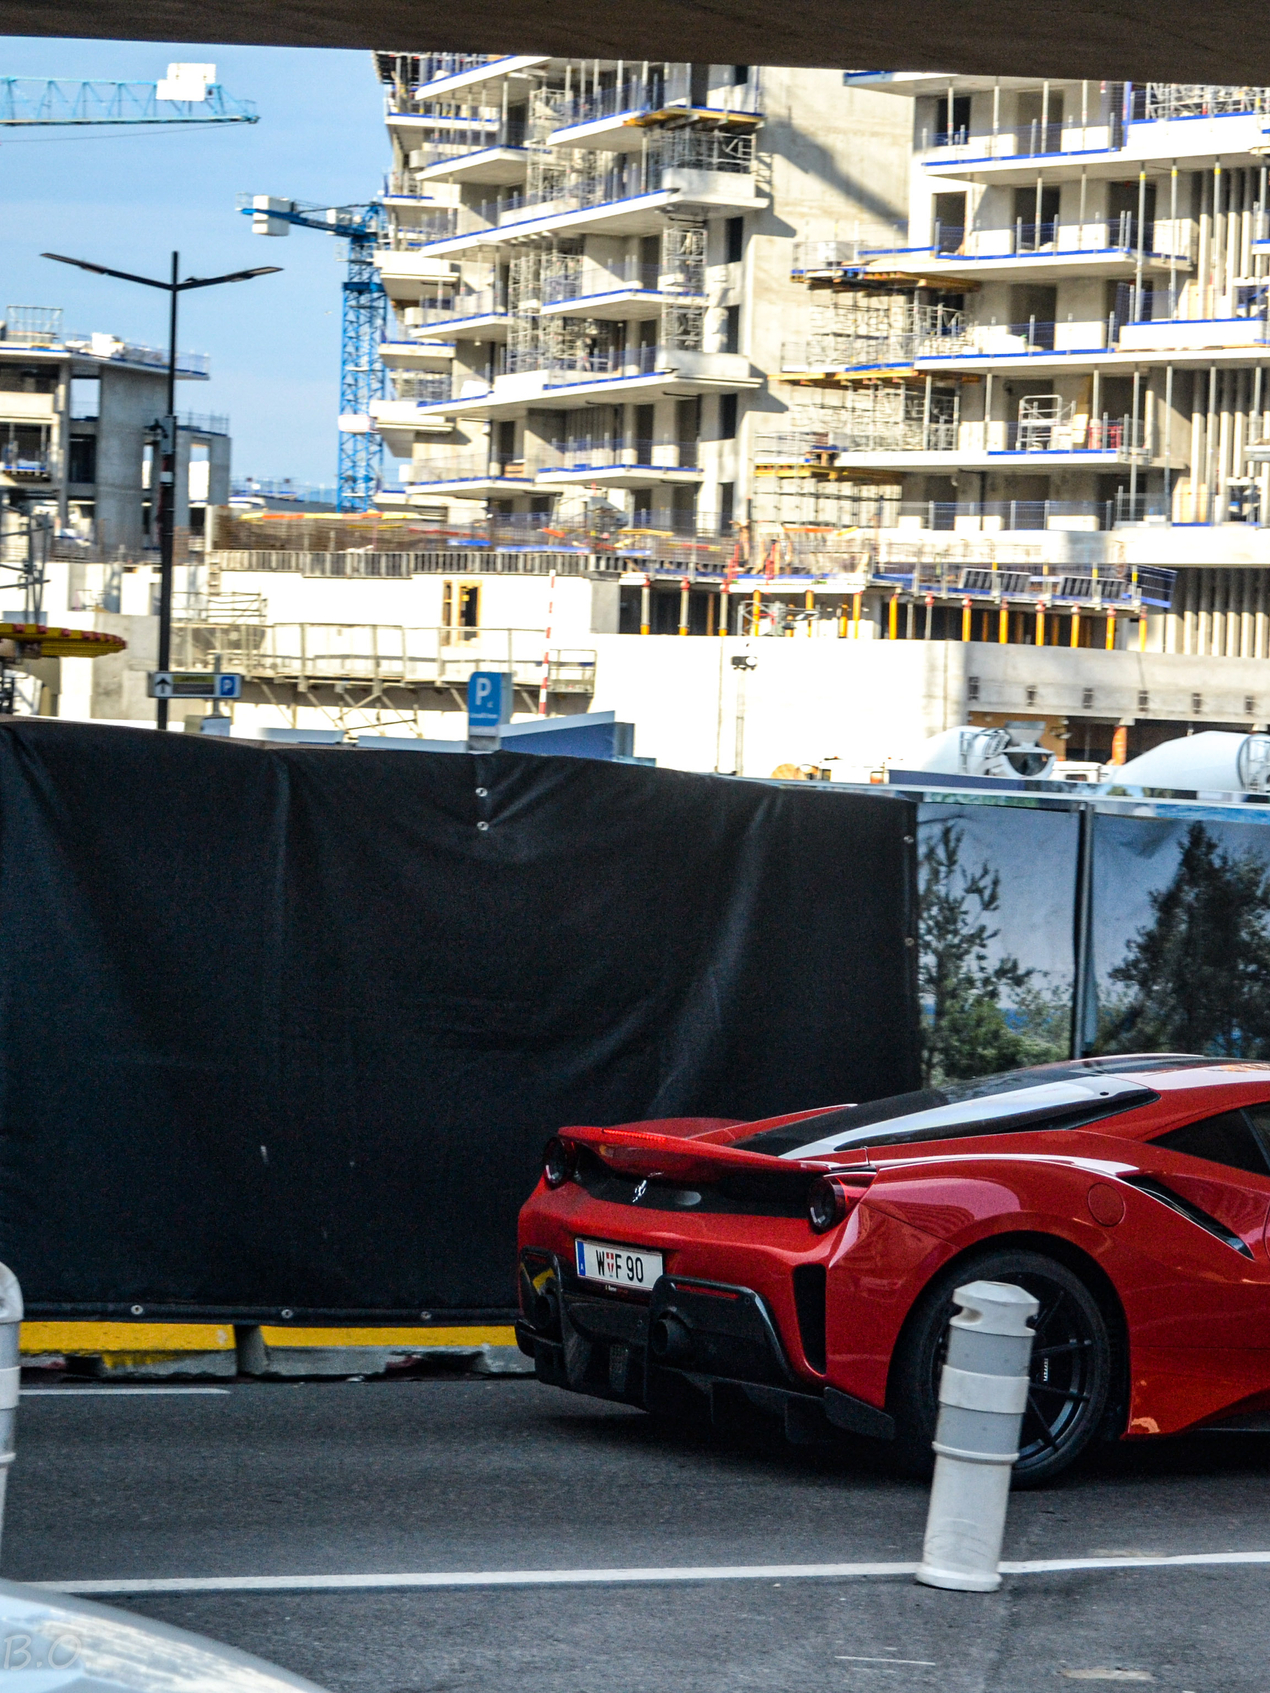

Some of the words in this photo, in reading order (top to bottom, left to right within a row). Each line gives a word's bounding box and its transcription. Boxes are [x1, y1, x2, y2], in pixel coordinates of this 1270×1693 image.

[475, 677, 493, 706] P
[596, 1249, 605, 1277] W
[615, 1253, 622, 1279] F
[626, 1255, 644, 1283] 90
